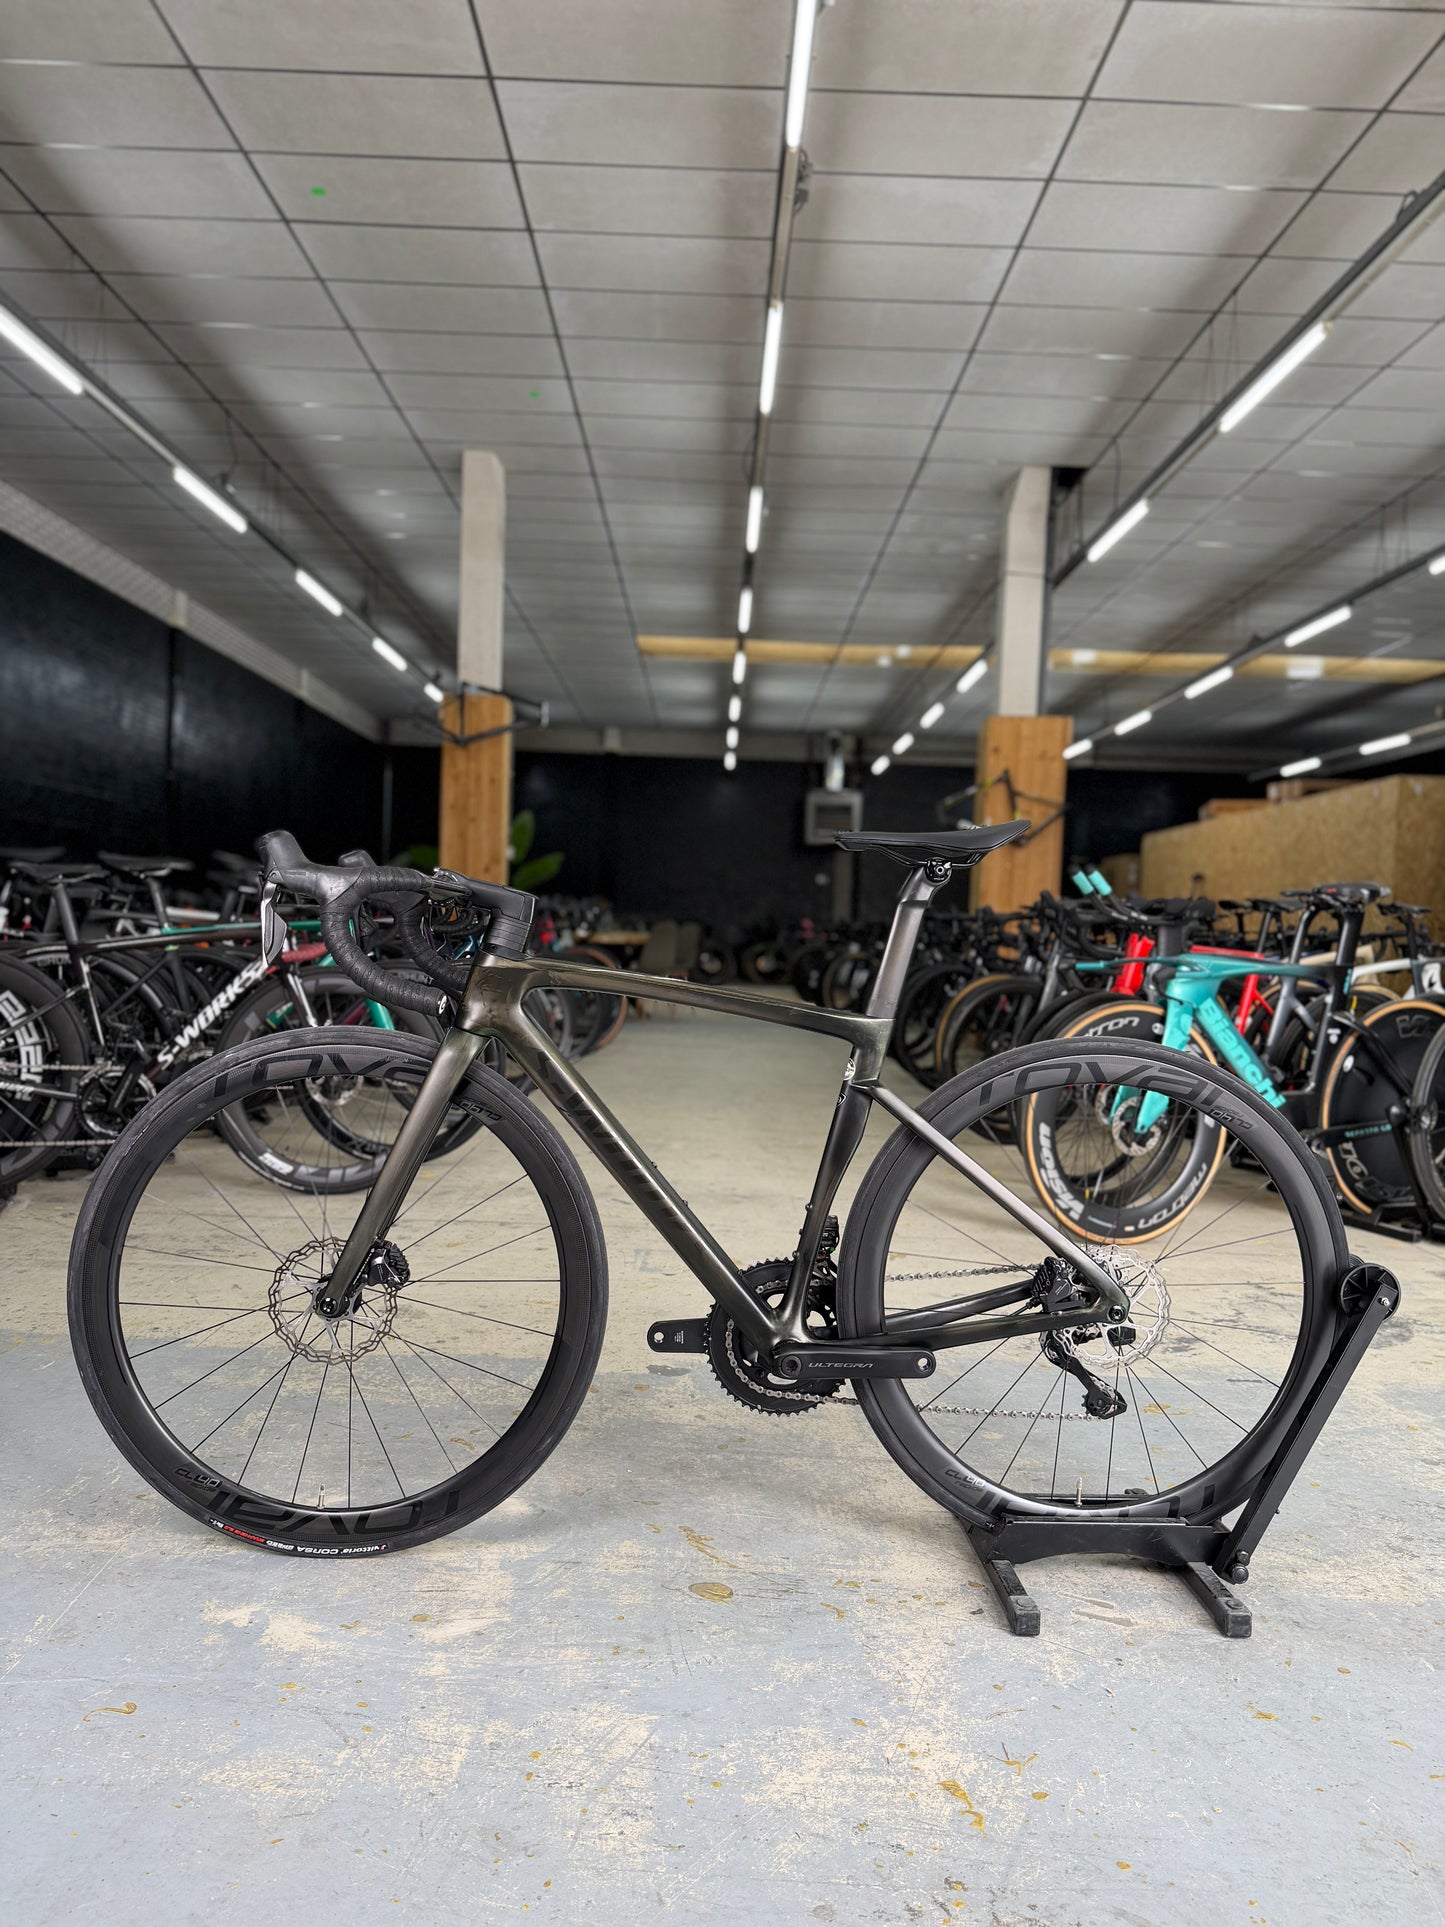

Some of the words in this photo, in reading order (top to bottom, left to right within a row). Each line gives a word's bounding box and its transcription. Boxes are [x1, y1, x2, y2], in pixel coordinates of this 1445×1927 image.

[1199, 997, 1287, 1109] Bianchi
[980, 1061, 1222, 1106] roval
[203, 1490, 461, 1535] roval
[297, 1546, 339, 1554] CORSA
